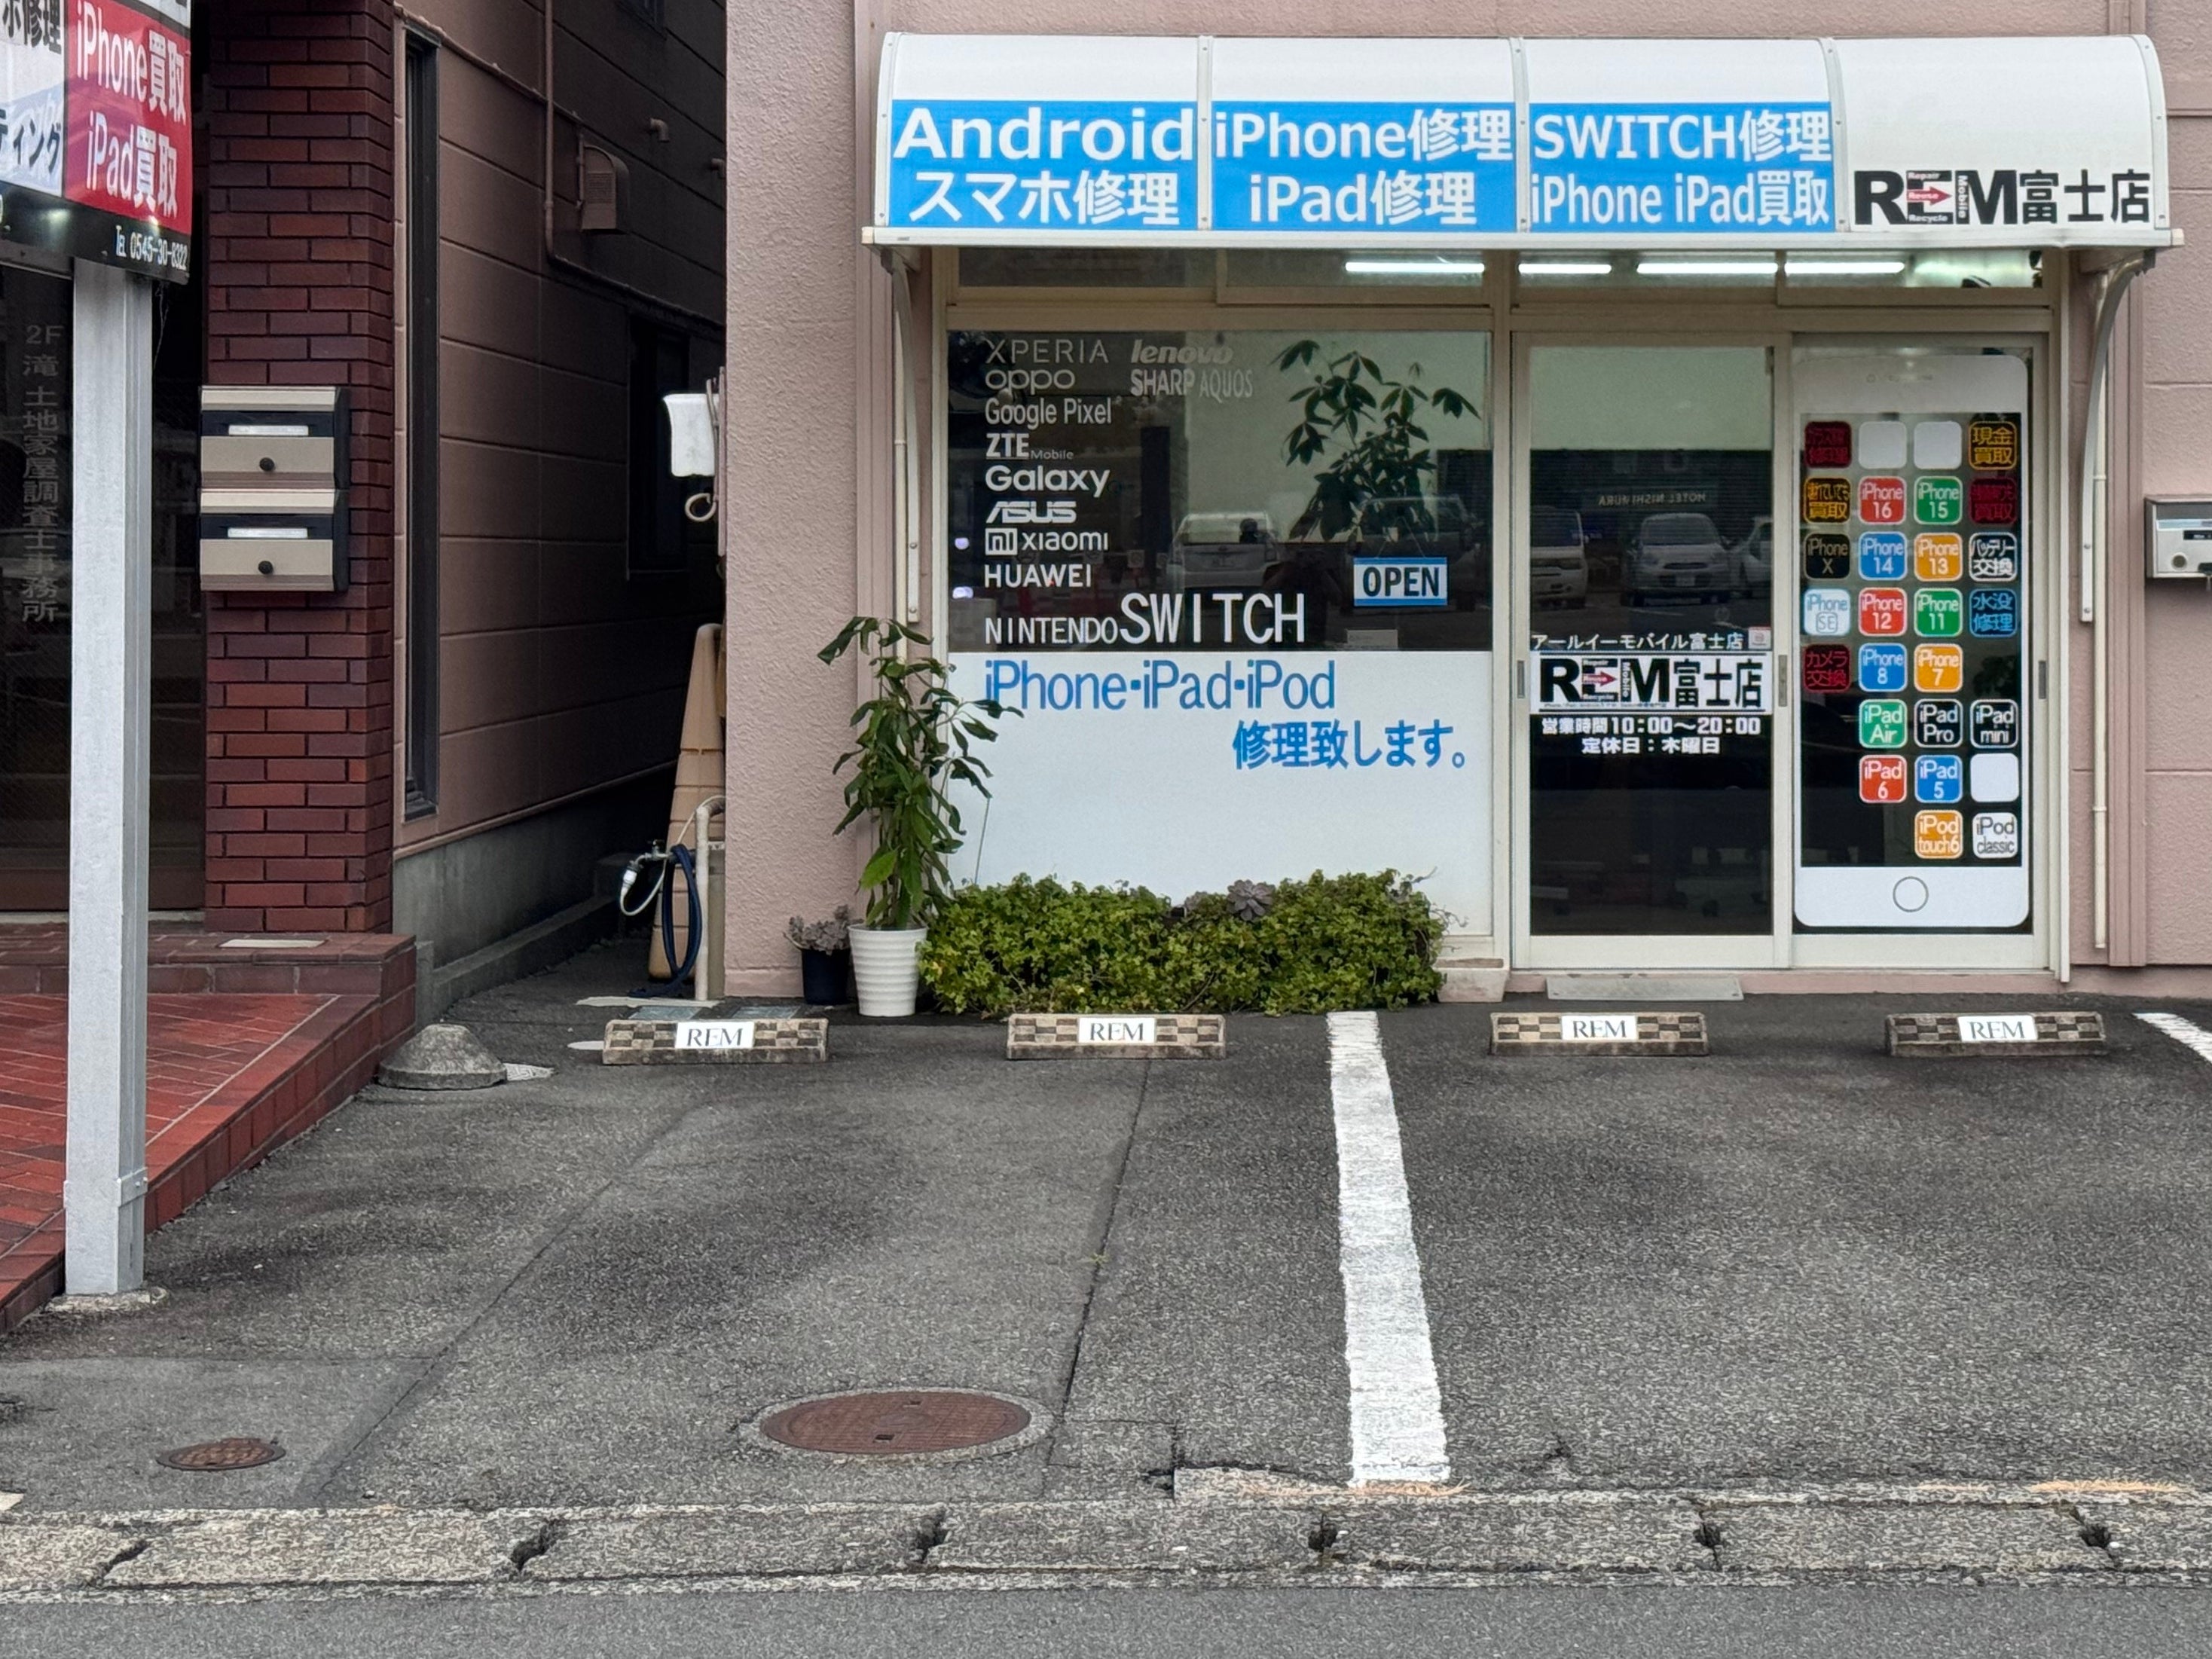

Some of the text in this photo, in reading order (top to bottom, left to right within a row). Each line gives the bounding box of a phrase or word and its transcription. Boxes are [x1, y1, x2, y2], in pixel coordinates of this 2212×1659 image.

[77, 2, 186, 125] iPhone買取
[893, 107, 1193, 160] Android
[1216, 109, 1513, 161] iPhone修理
[1534, 111, 1831, 163] SWITCH修理
[87, 111, 178, 218] iPad買取
[909, 171, 1179, 225] スマホ修理
[1250, 171, 1477, 225] iPad修理
[1531, 170, 1829, 226] iPhone iPad買取
[26, 325, 63, 344] 2F
[985, 339, 1109, 364] XPERIA
[1131, 339, 1234, 364] lenovo
[1131, 368, 1254, 404] SHARP AQUOS
[985, 397, 1112, 429] Google Pixel
[1972, 426, 2013, 445] 現金
[986, 432, 1074, 460] ZTE Mobile
[1974, 448, 2012, 464] 買取
[985, 465, 1111, 497] Galaxy
[1862, 482, 1903, 500] iPhone
[1917, 482, 1960, 500] iPhone
[986, 501, 1077, 524] ASUS
[1809, 501, 1847, 518] 買取
[1873, 503, 1892, 518] 16
[1929, 501, 1948, 518] 15
[1022, 530, 1109, 551] xiaomi
[1809, 537, 1847, 556] iPhone
[1862, 538, 1904, 556] iPhone
[1917, 538, 1959, 556] iPhone
[1972, 539, 2015, 556] バッテリー
[1822, 558, 1834, 574] X
[1873, 558, 1893, 573] 14
[1929, 558, 1948, 574] 13
[1973, 558, 2014, 576] 交換
[985, 564, 1092, 588] HUAWEI
[1362, 566, 1441, 598] OPEN
[1808, 594, 1847, 613] iPhone
[1862, 594, 1903, 612] iPhone
[1917, 594, 1959, 612] iPhone
[1973, 593, 2013, 610] 水没
[1819, 615, 1835, 630] SE
[1872, 613, 1892, 630] 12
[1929, 614, 1945, 630] 11
[1973, 613, 2012, 631] 修理
[1532, 632, 1743, 650] アールイーモバイル富士店
[1808, 651, 1847, 668] カメラ
[1862, 649, 1904, 667] iPhone
[1917, 649, 1959, 668] iPhone
[1807, 669, 1847, 686] 交換
[1877, 669, 1888, 684] 8
[1933, 669, 1943, 686] 7
[1865, 704, 1902, 723] iPad
[1920, 704, 1958, 723] iPad
[1975, 705, 2015, 724] iPad
[1870, 725, 1897, 743] Air
[1923, 724, 1954, 742] Pro
[1981, 725, 2009, 743] mini
[1233, 720, 1465, 769] 修理致します。
[1864, 759, 1902, 779] iPad
[1920, 759, 1957, 779] iPad
[1877, 782, 1889, 799] 6
[1934, 781, 1945, 799] 5
[1920, 814, 1960, 834] iPod
[1976, 816, 2015, 835] iPod
[1977, 836, 2015, 854] classic
[686, 1027, 743, 1046] REM
[1089, 1022, 1144, 1041] REM
[1572, 1020, 1627, 1039] REM
[1969, 1021, 2026, 1039] REM
